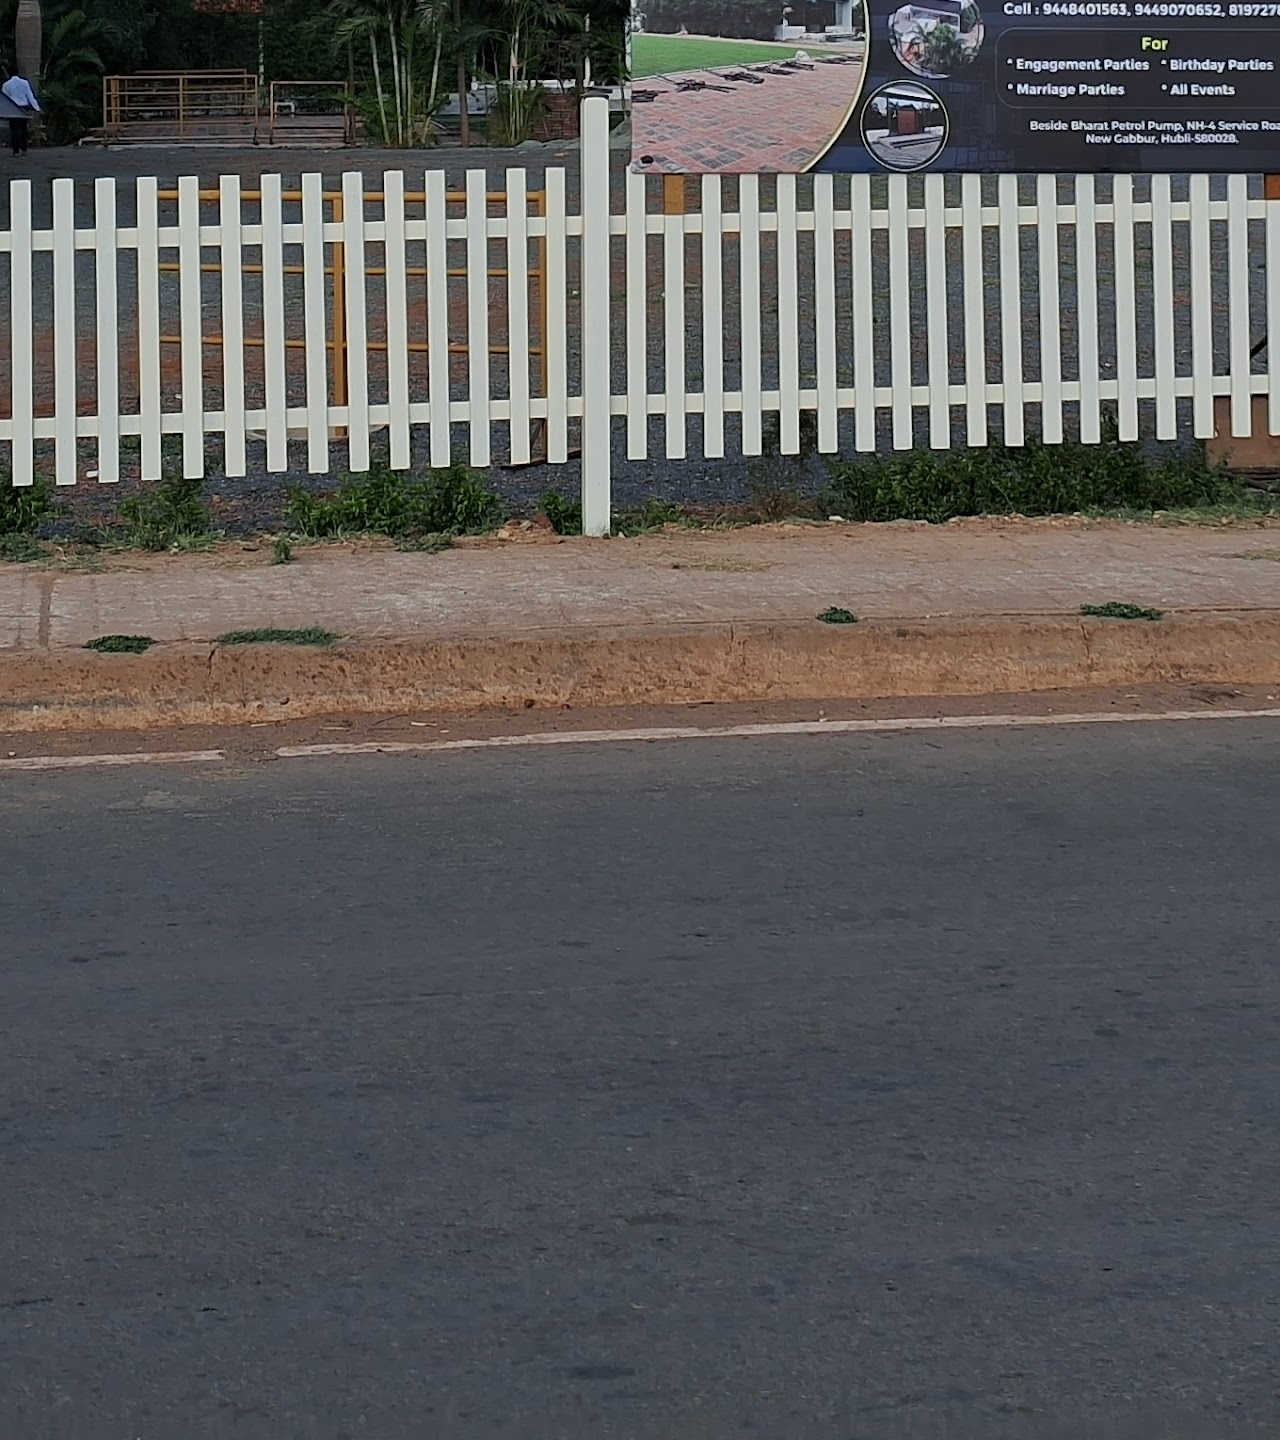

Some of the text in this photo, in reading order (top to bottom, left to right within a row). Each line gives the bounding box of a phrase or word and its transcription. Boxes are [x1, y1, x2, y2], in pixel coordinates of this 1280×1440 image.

[1003, 1, 1032, 15] Cell
[1042, 2, 1132, 17] 9448401563,
[1134, 3, 1226, 18] 9449070652,
[1141, 36, 1169, 51] For
[1015, 57, 1150, 73] Engagement Parties
[1169, 58, 1275, 74] Birthday Parties
[1016, 82, 1126, 98] Marriage Parties
[1169, 83, 1236, 96] All Events
[1029, 119, 1069, 131] Beside
[1070, 120, 1109, 131] Bharat
[1110, 120, 1146, 131] Petrol
[1147, 120, 1185, 133] Pump,
[1186, 120, 1216, 132] NH-4
[1217, 120, 1260, 131] Service
[1085, 133, 1113, 144] New
[1113, 133, 1160, 145] Gabbur,
